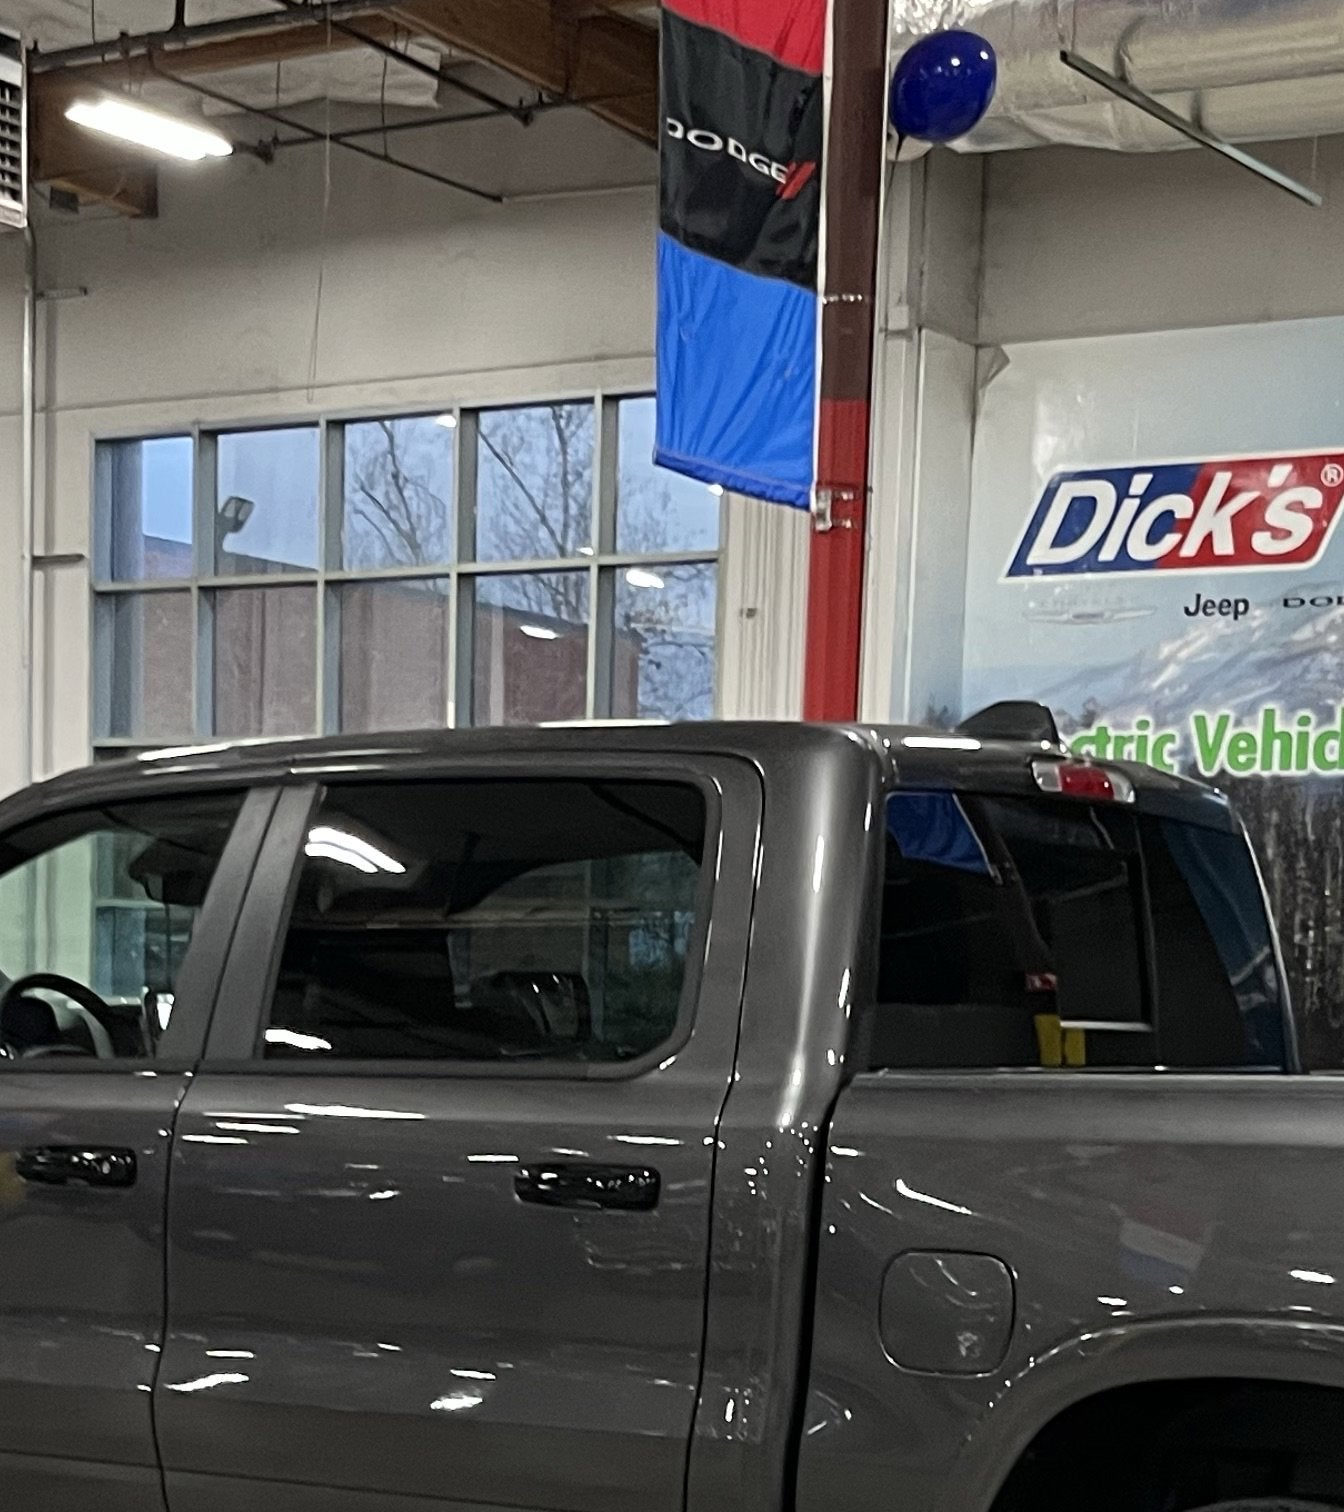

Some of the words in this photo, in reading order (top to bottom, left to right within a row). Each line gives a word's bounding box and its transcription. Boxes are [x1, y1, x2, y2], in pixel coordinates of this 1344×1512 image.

[666, 116, 790, 184] DODGE
[1025, 463, 1324, 566] Dick's
[1183, 593, 1250, 620] Jeep
